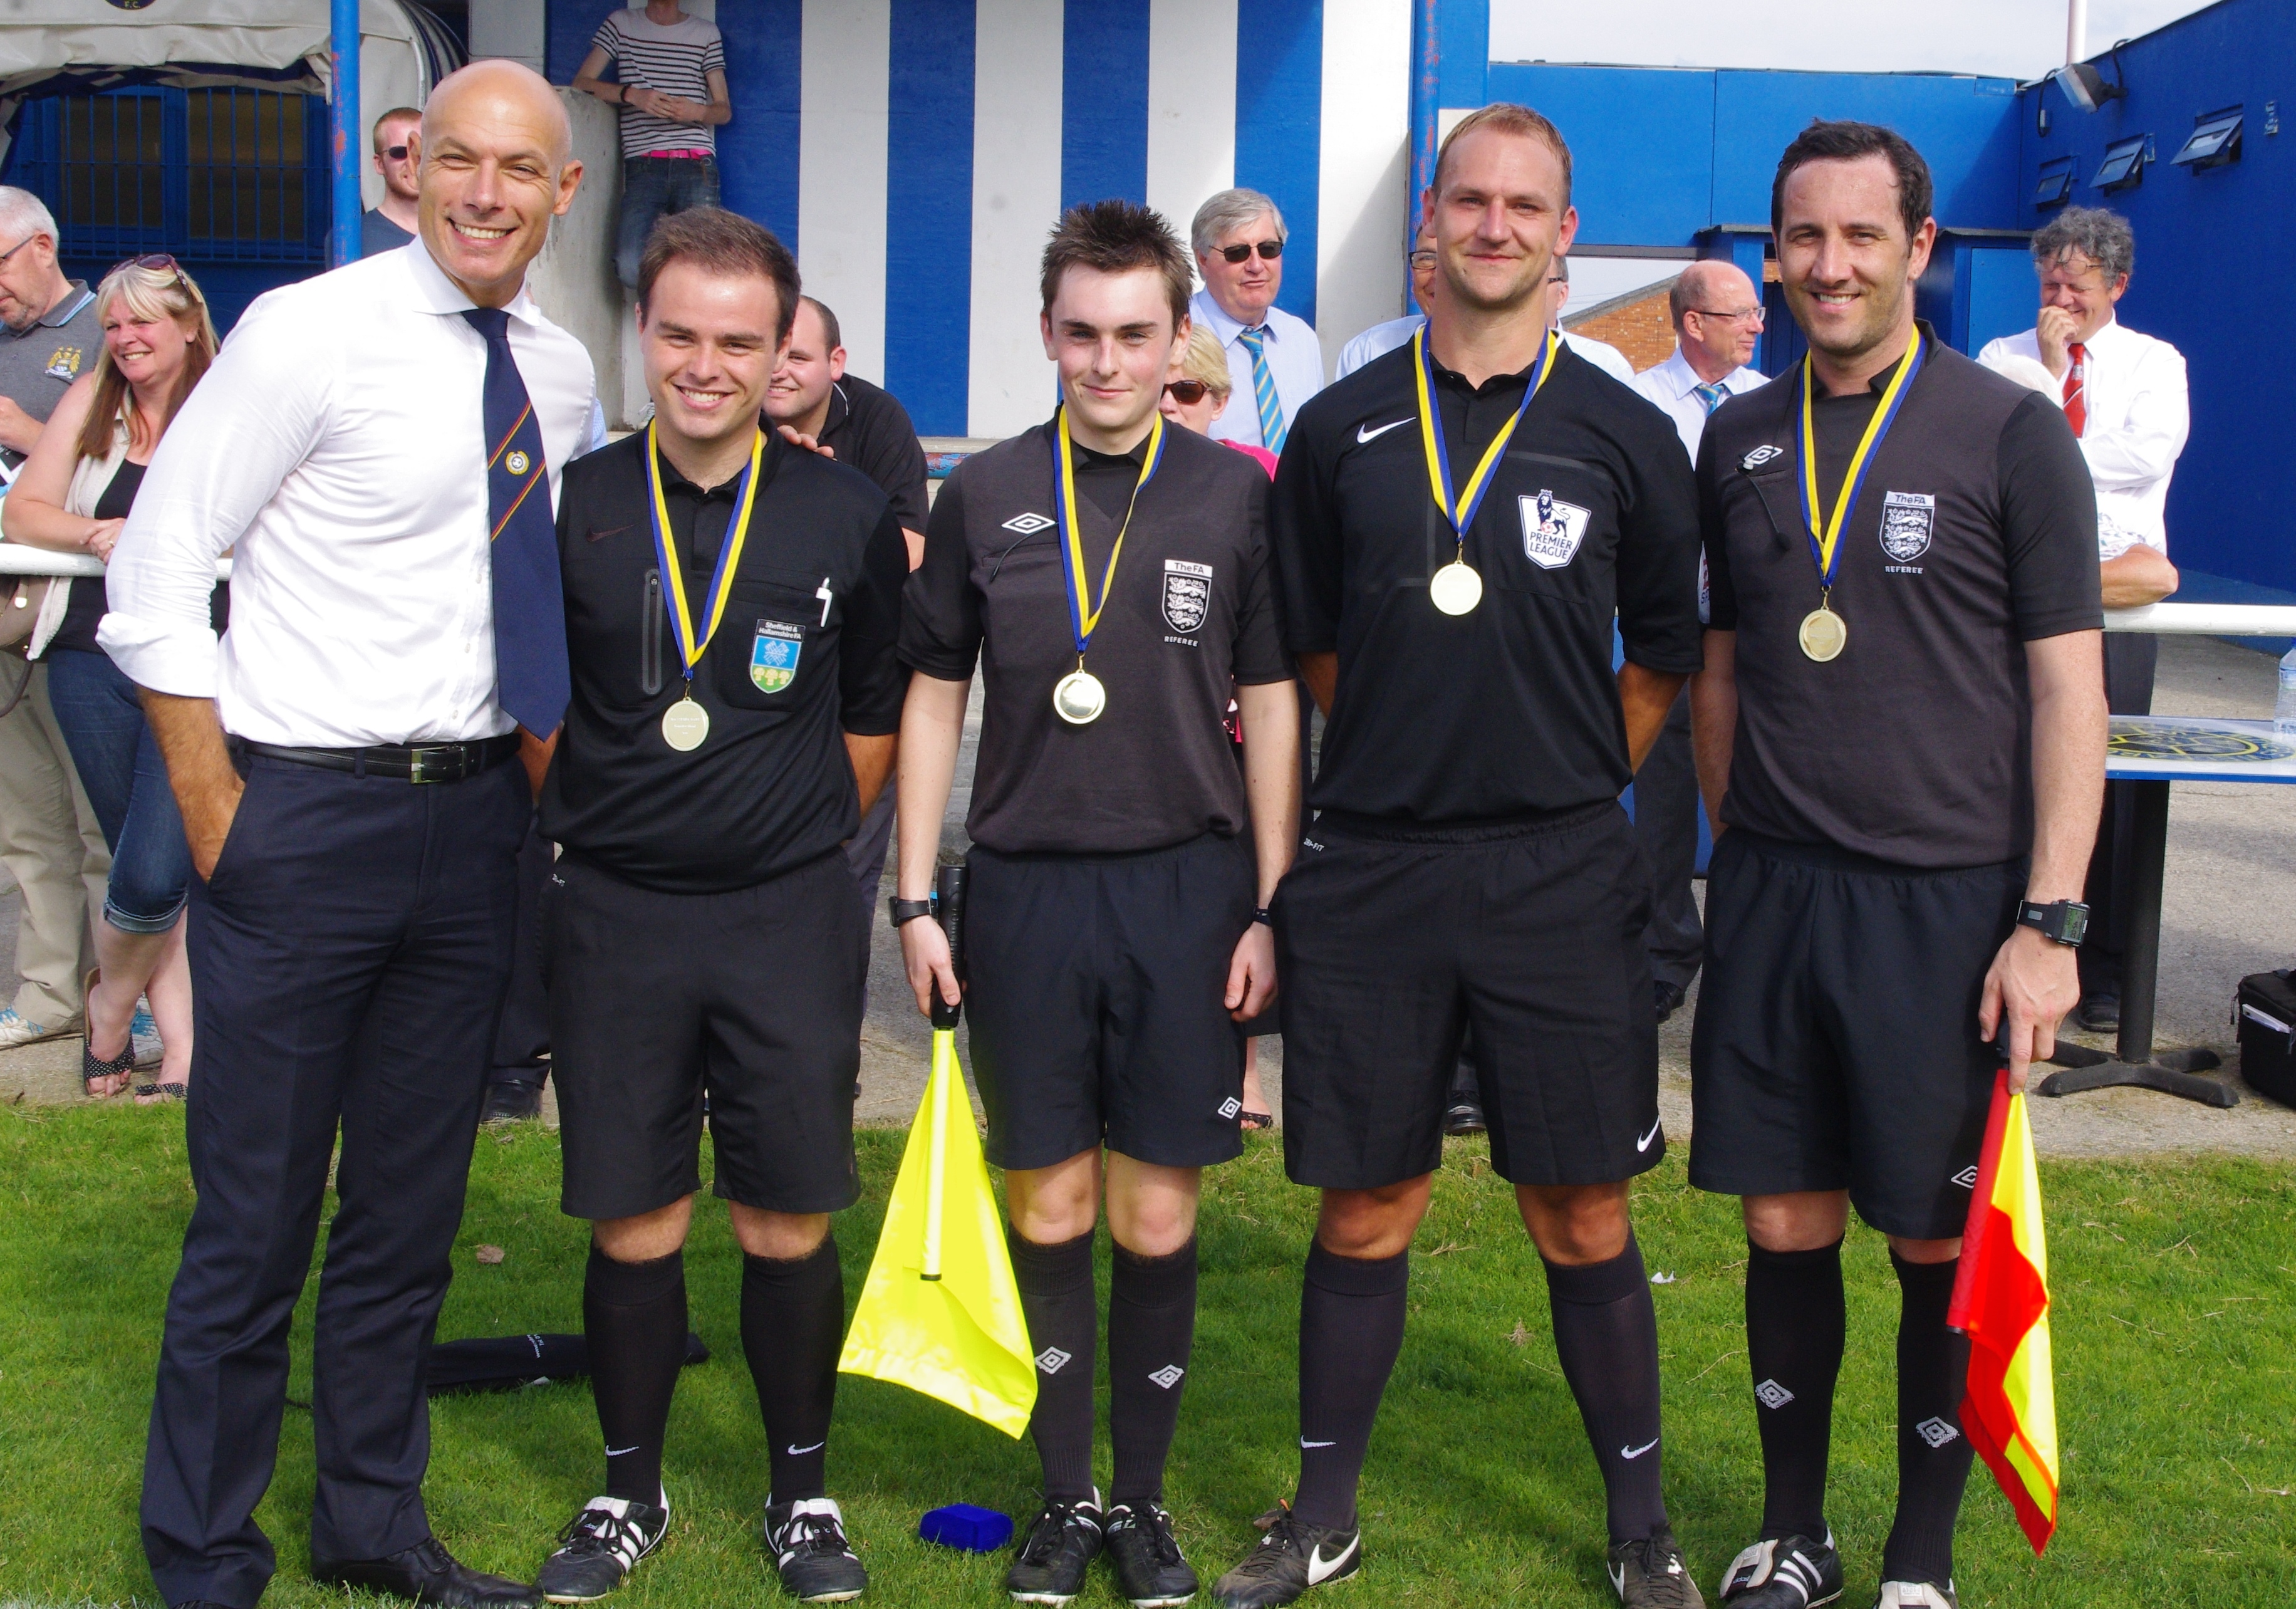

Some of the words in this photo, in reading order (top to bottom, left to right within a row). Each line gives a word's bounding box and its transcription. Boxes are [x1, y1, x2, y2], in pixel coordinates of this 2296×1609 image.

[1530, 532, 1572, 550] PREMIER
[1530, 543, 1568, 559] LEAGUE
[1884, 566, 1924, 574] REFEREE
[758, 627, 794, 638] Hallamshire
[765, 622, 792, 632] Sheffield
[1164, 635, 1198, 647] REFEREE
